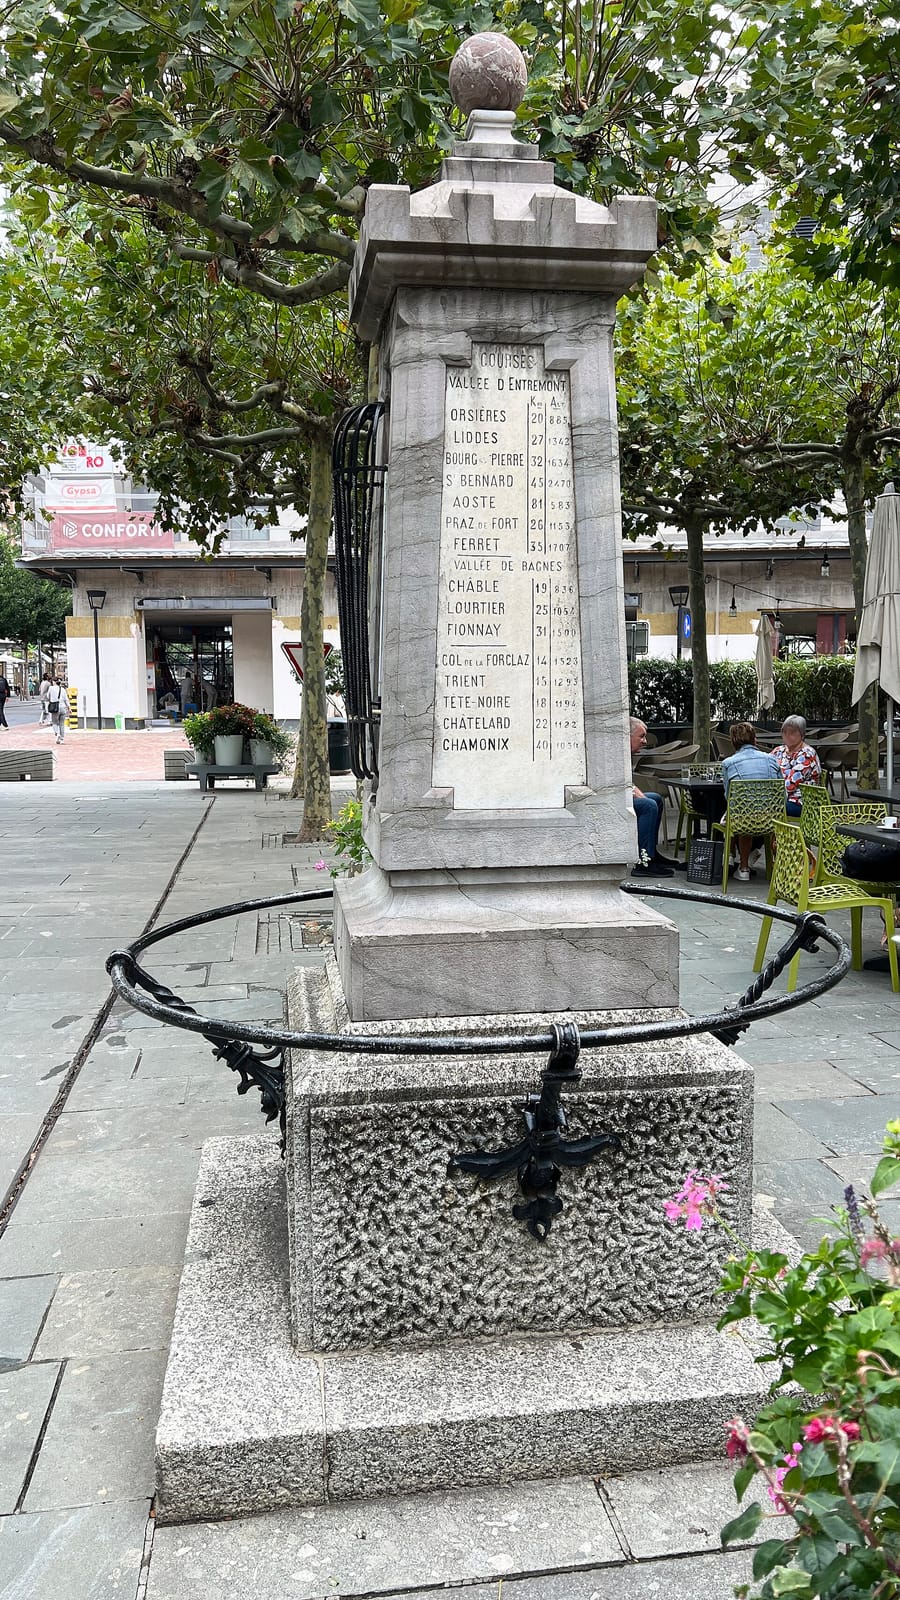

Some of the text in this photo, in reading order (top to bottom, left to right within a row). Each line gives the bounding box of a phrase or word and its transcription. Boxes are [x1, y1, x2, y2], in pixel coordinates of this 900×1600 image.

[481, 352, 536, 369] COURSES
[450, 406, 568, 425] ORSIÈRES 20 885
[454, 432, 570, 446] LIDDES 27 1342
[446, 452, 477, 465] BOURG
[531, 456, 543, 467] 32
[548, 458, 569, 467] 1634
[460, 475, 514, 488] BERNARD
[531, 477, 544, 488] 45
[453, 496, 496, 508] AOSTE
[531, 499, 543, 509] 81
[446, 518, 474, 529] PRAZ
[492, 518, 518, 530] FORT
[530, 520, 544, 530] 26
[454, 538, 570, 552] FERRET 35 1707
[501, 561, 514, 571] DE
[522, 561, 562, 572] BAGNES
[449, 577, 499, 593] CHÂBLE
[536, 583, 547, 593] 19
[448, 602, 505, 615] LOURTIER
[536, 605, 548, 615] 25
[448, 623, 501, 636] FIONNAY
[536, 626, 547, 636] 31
[443, 654, 462, 666] COL
[487, 654, 530, 666] FORCLAZ
[536, 655, 547, 665] 14
[445, 675, 486, 687] TRIENT
[536, 676, 547, 686] 15
[536, 697, 547, 708] 18
[443, 714, 577, 730] CHÂTELARD 22 1122
[443, 738, 509, 751] CHAMONIX
[536, 741, 548, 750] 40
